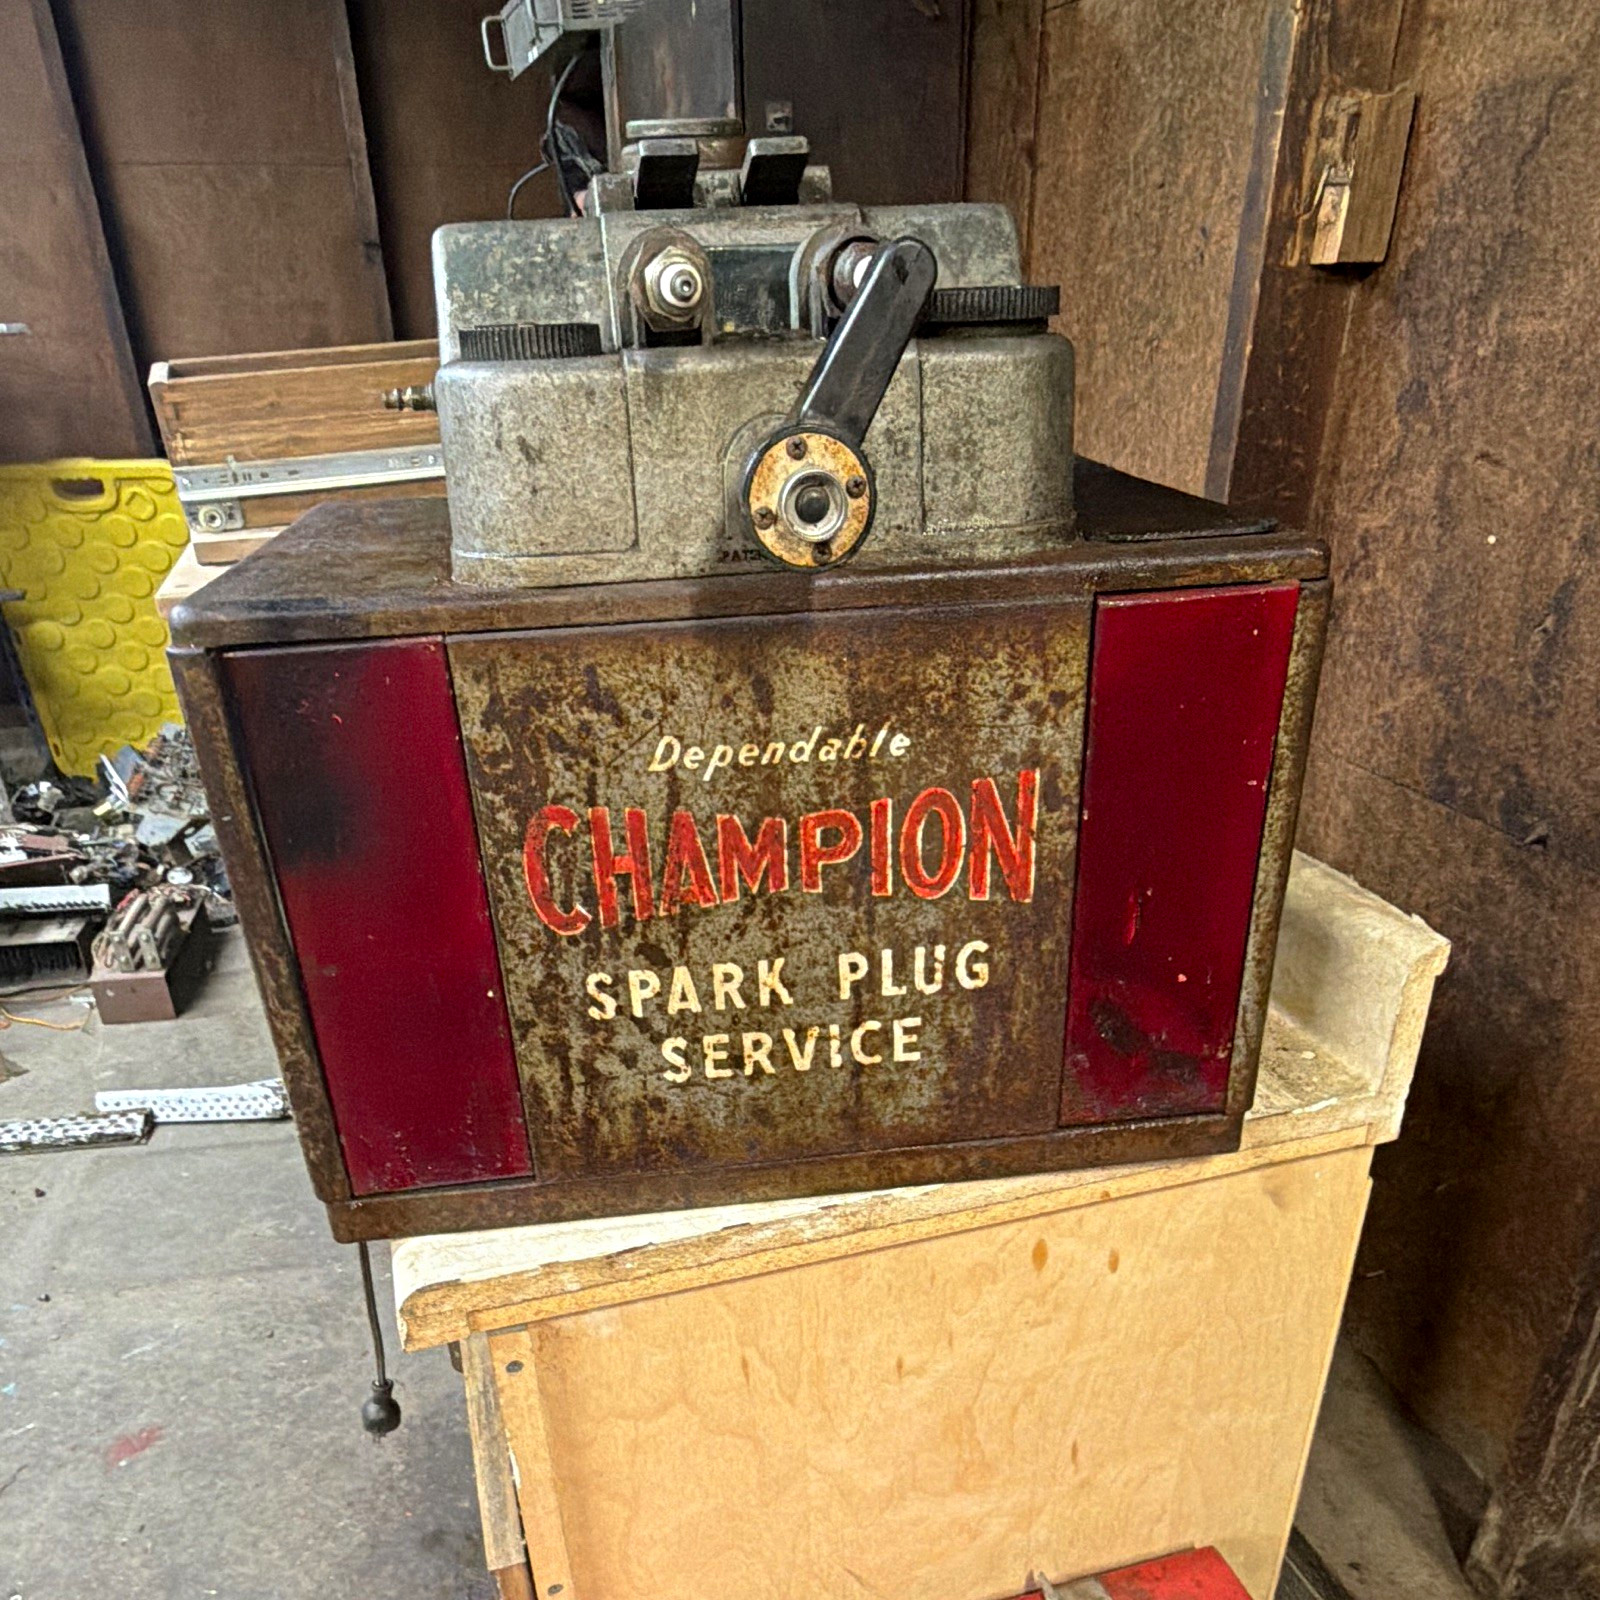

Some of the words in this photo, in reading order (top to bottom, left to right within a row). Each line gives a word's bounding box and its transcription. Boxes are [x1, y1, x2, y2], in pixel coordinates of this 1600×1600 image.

[649, 721, 912, 782] Dependable
[523, 768, 1041, 936] CHAMPION
[585, 956, 794, 1021] SPARK
[838, 940, 990, 1000] PLUG
[661, 1016, 923, 1083] SERVICE
